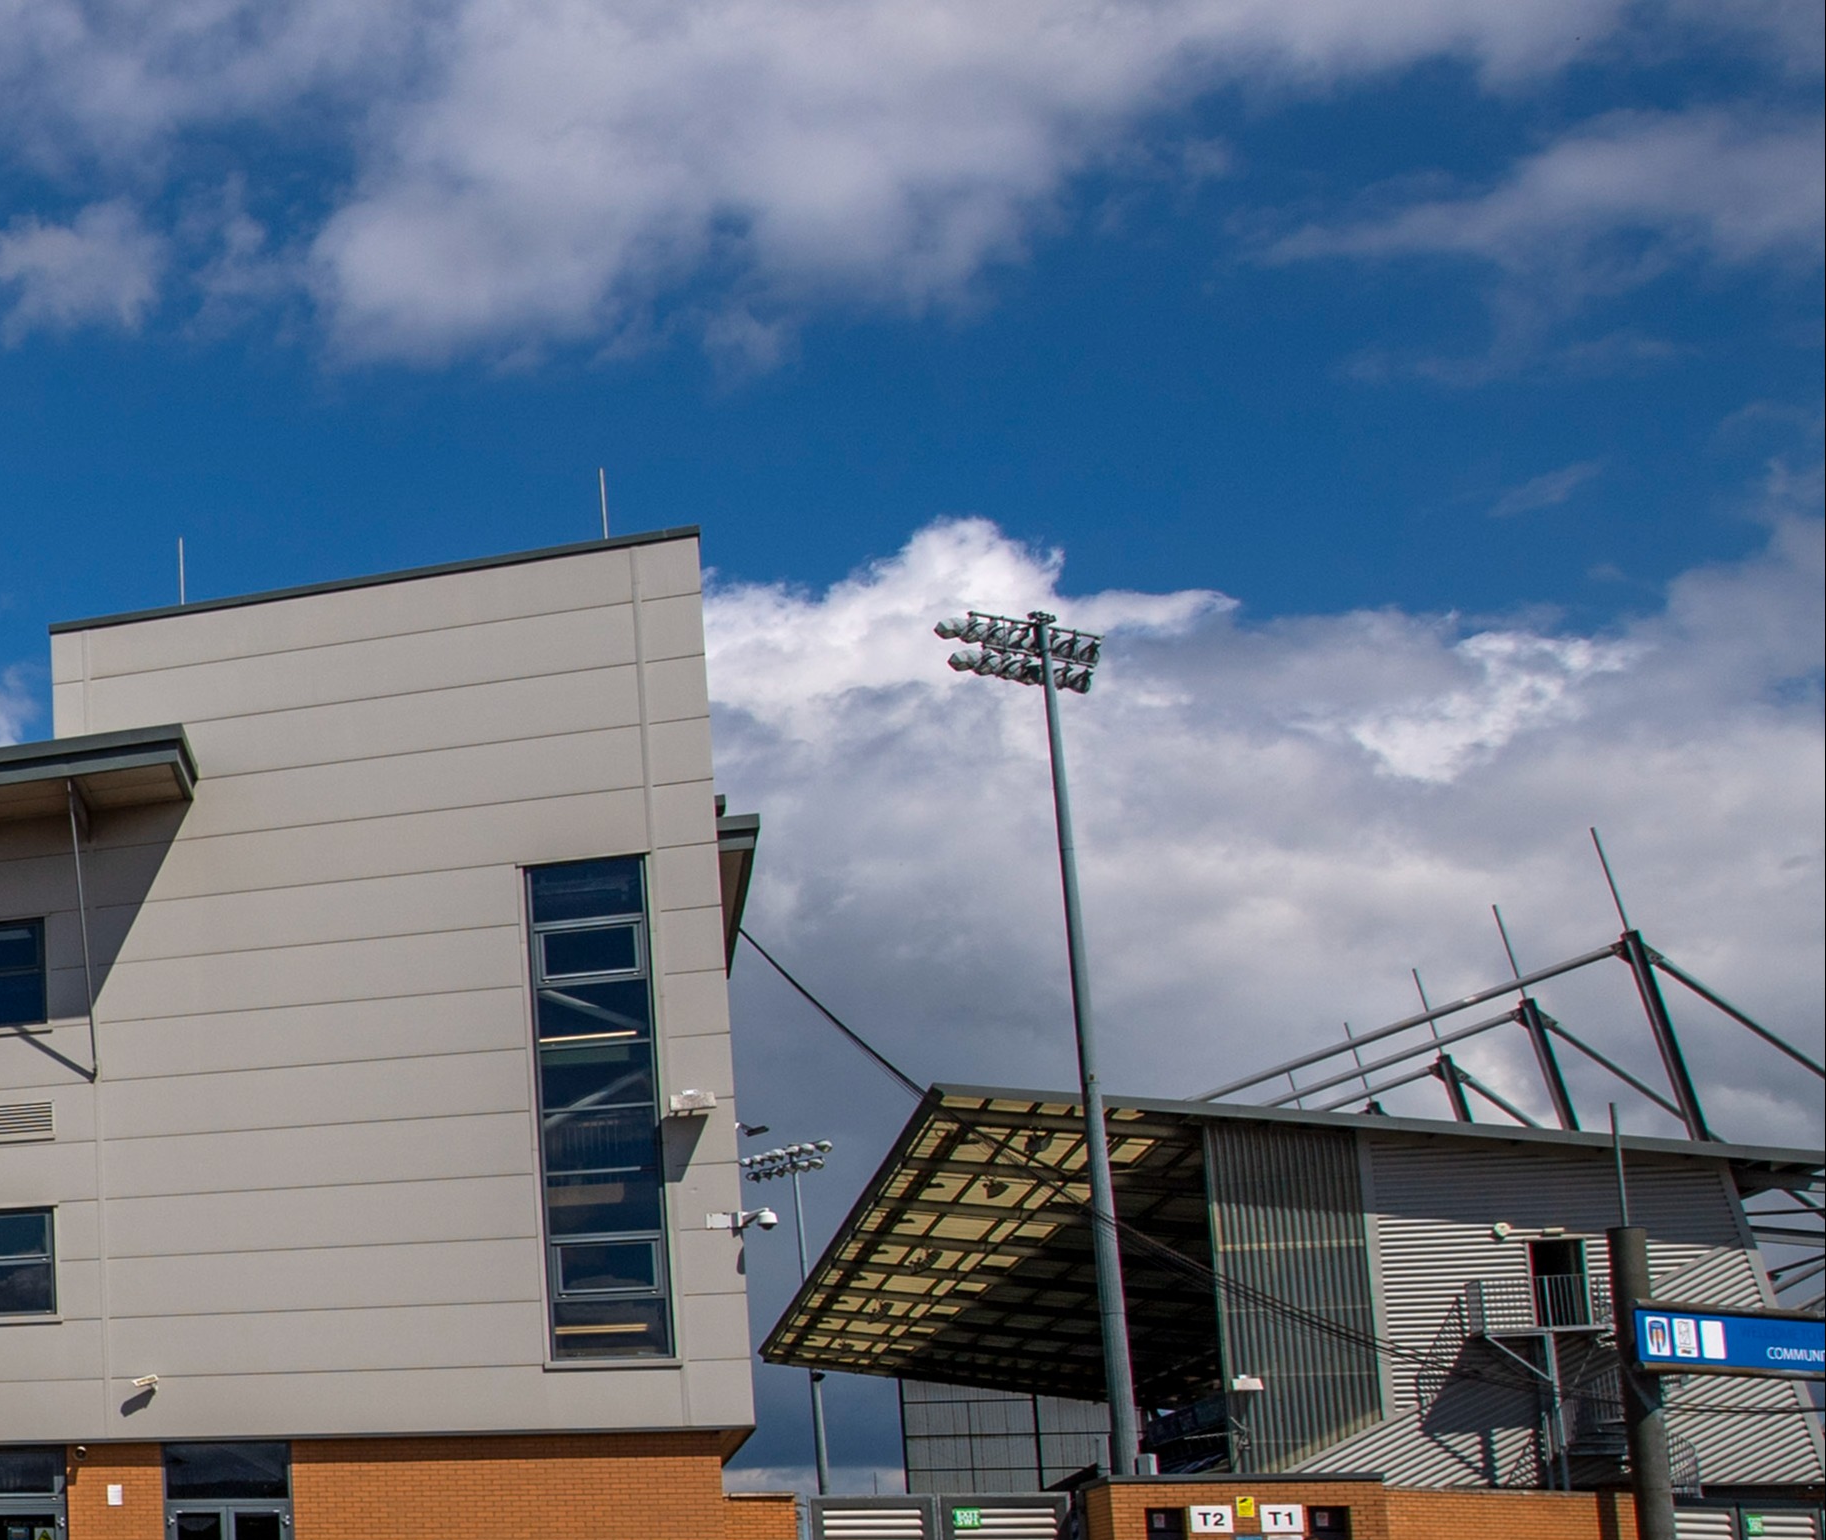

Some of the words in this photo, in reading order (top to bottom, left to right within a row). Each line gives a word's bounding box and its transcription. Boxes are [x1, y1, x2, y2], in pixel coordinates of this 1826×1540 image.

[1766, 1346, 1825, 1362] COMMUNI
[1198, 1512, 1225, 1526] T2
[1268, 1511, 1294, 1526] T1
